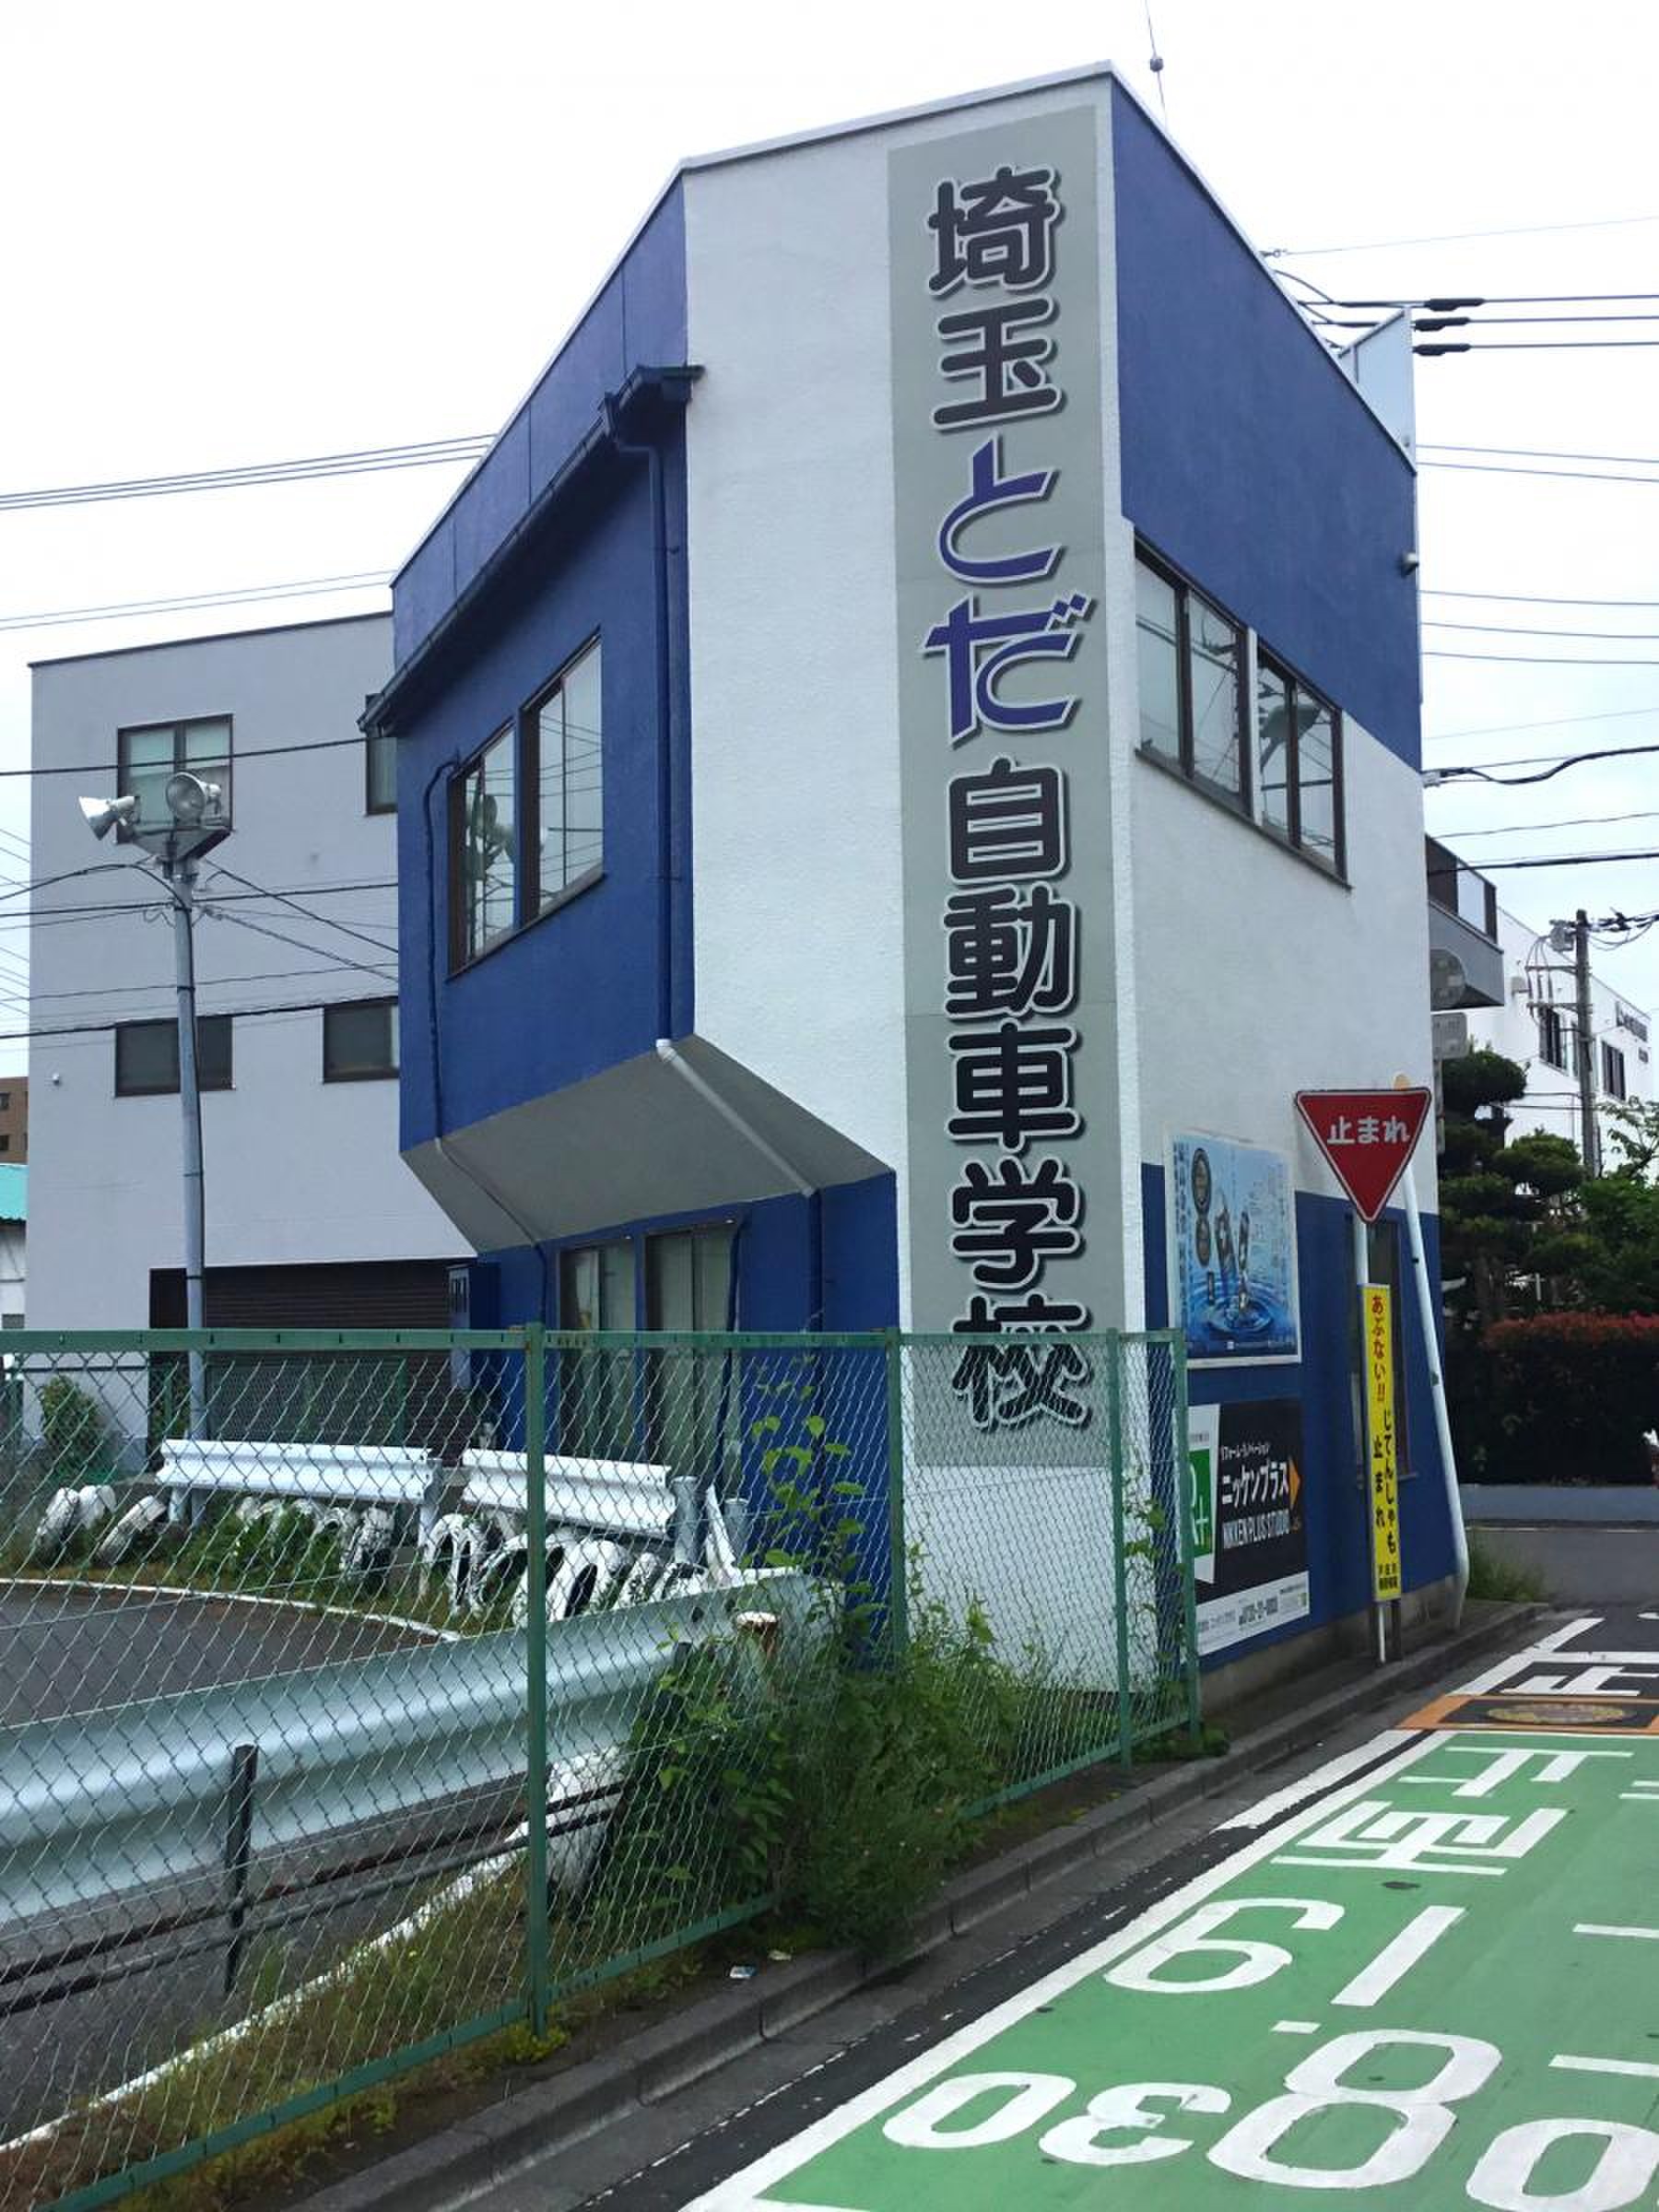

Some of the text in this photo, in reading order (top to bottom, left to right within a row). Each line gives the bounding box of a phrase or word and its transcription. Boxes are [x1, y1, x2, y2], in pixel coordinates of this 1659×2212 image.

[1327, 1115, 1410, 1145] 止まれ
[1221, 1460, 1289, 1508] ニッケンプラス
